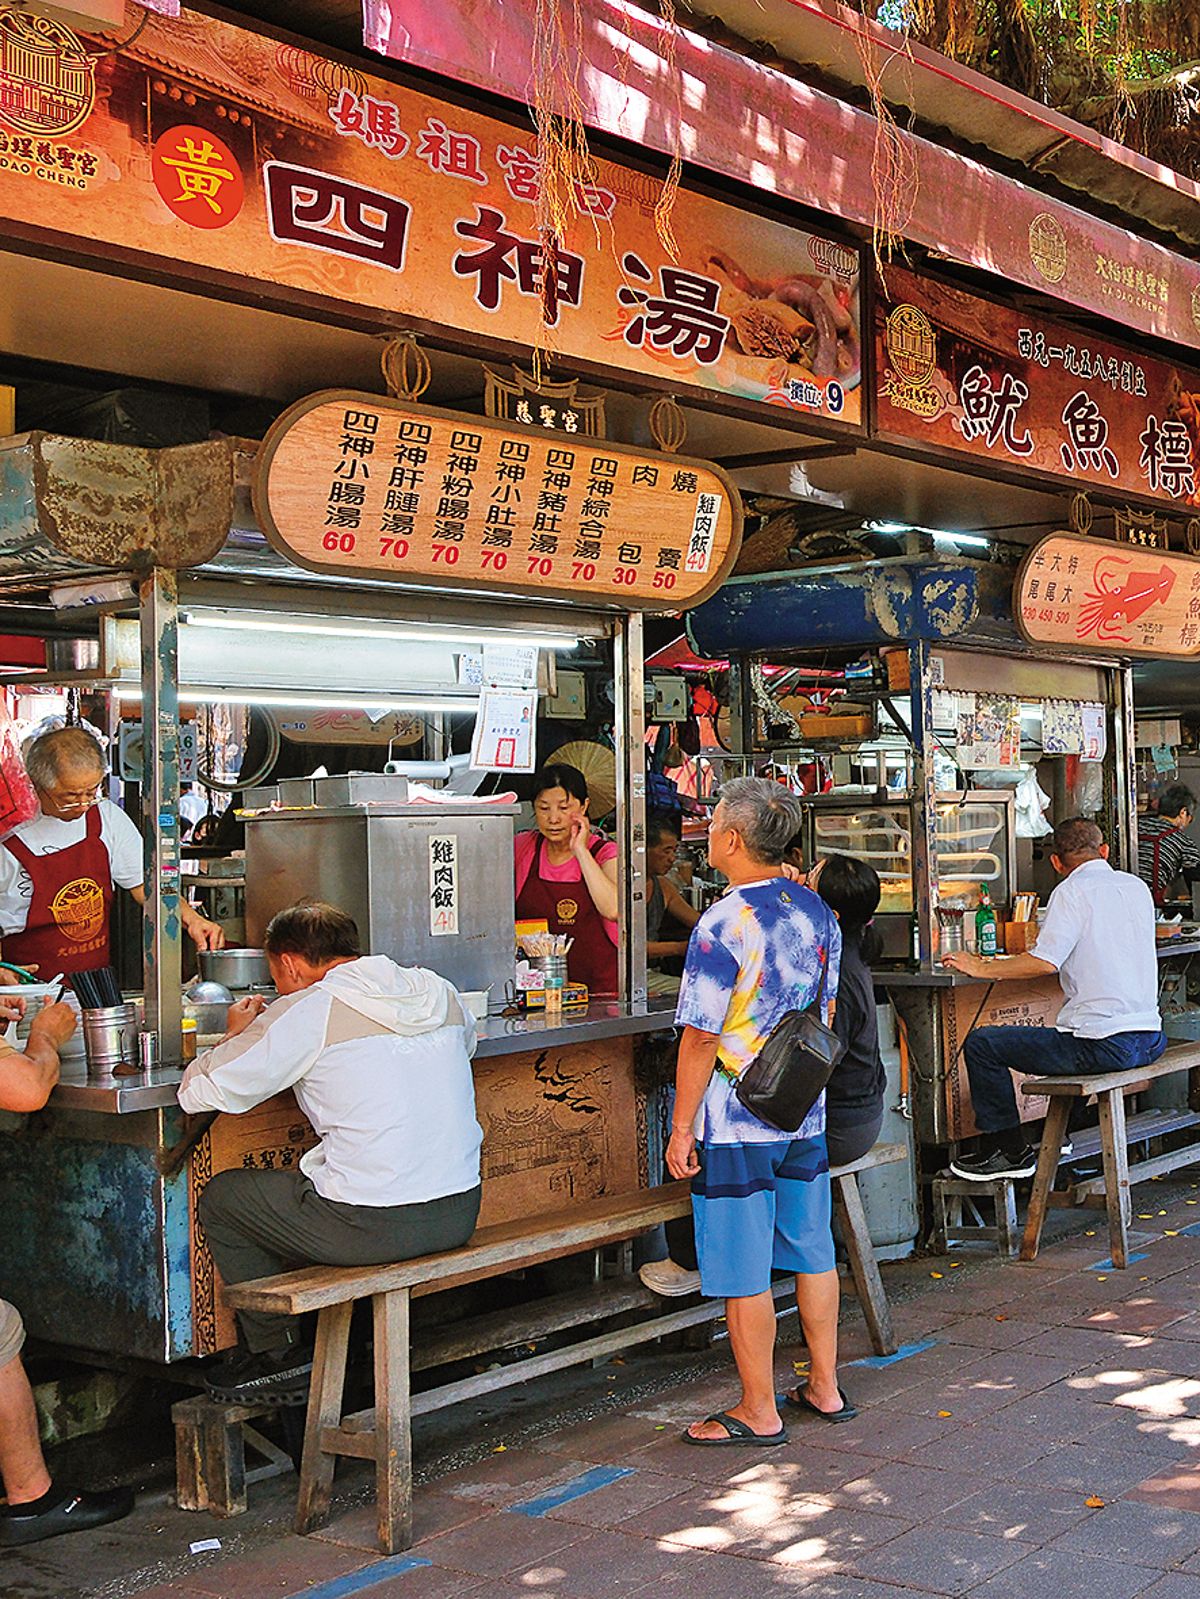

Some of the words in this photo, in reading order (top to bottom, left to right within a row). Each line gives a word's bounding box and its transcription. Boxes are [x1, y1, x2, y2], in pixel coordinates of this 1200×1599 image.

[37, 166, 87, 190] CHENG
[160, 137, 236, 215] 黃
[330, 87, 619, 222] 媽祖宮口
[263, 158, 732, 367] 四神湯
[1018, 328, 1148, 398] 西元一九五八年創立
[515, 400, 580, 433] 慈聖宮
[959, 364, 1196, 498] 魷魚標
[324, 409, 380, 530] 四神小腸湯
[431, 430, 483, 542] 四神粉腸湯
[480, 439, 531, 549] 四神小肚湯
[527, 448, 576, 555] 四神豬肚湯
[572, 456, 619, 560] 四神綜合湯
[322, 531, 356, 553] 60
[691, 493, 716, 554] 雞肉飯
[379, 537, 409, 559] 70
[431, 543, 460, 565] 70
[480, 550, 508, 571] 70
[527, 556, 553, 577] 70
[571, 561, 596, 581] 70
[687, 551, 707, 570] 40
[612, 566, 637, 586] 30
[652, 571, 677, 590] 50
[430, 839, 455, 909] 雞肉飯
[434, 911, 456, 931] 40
